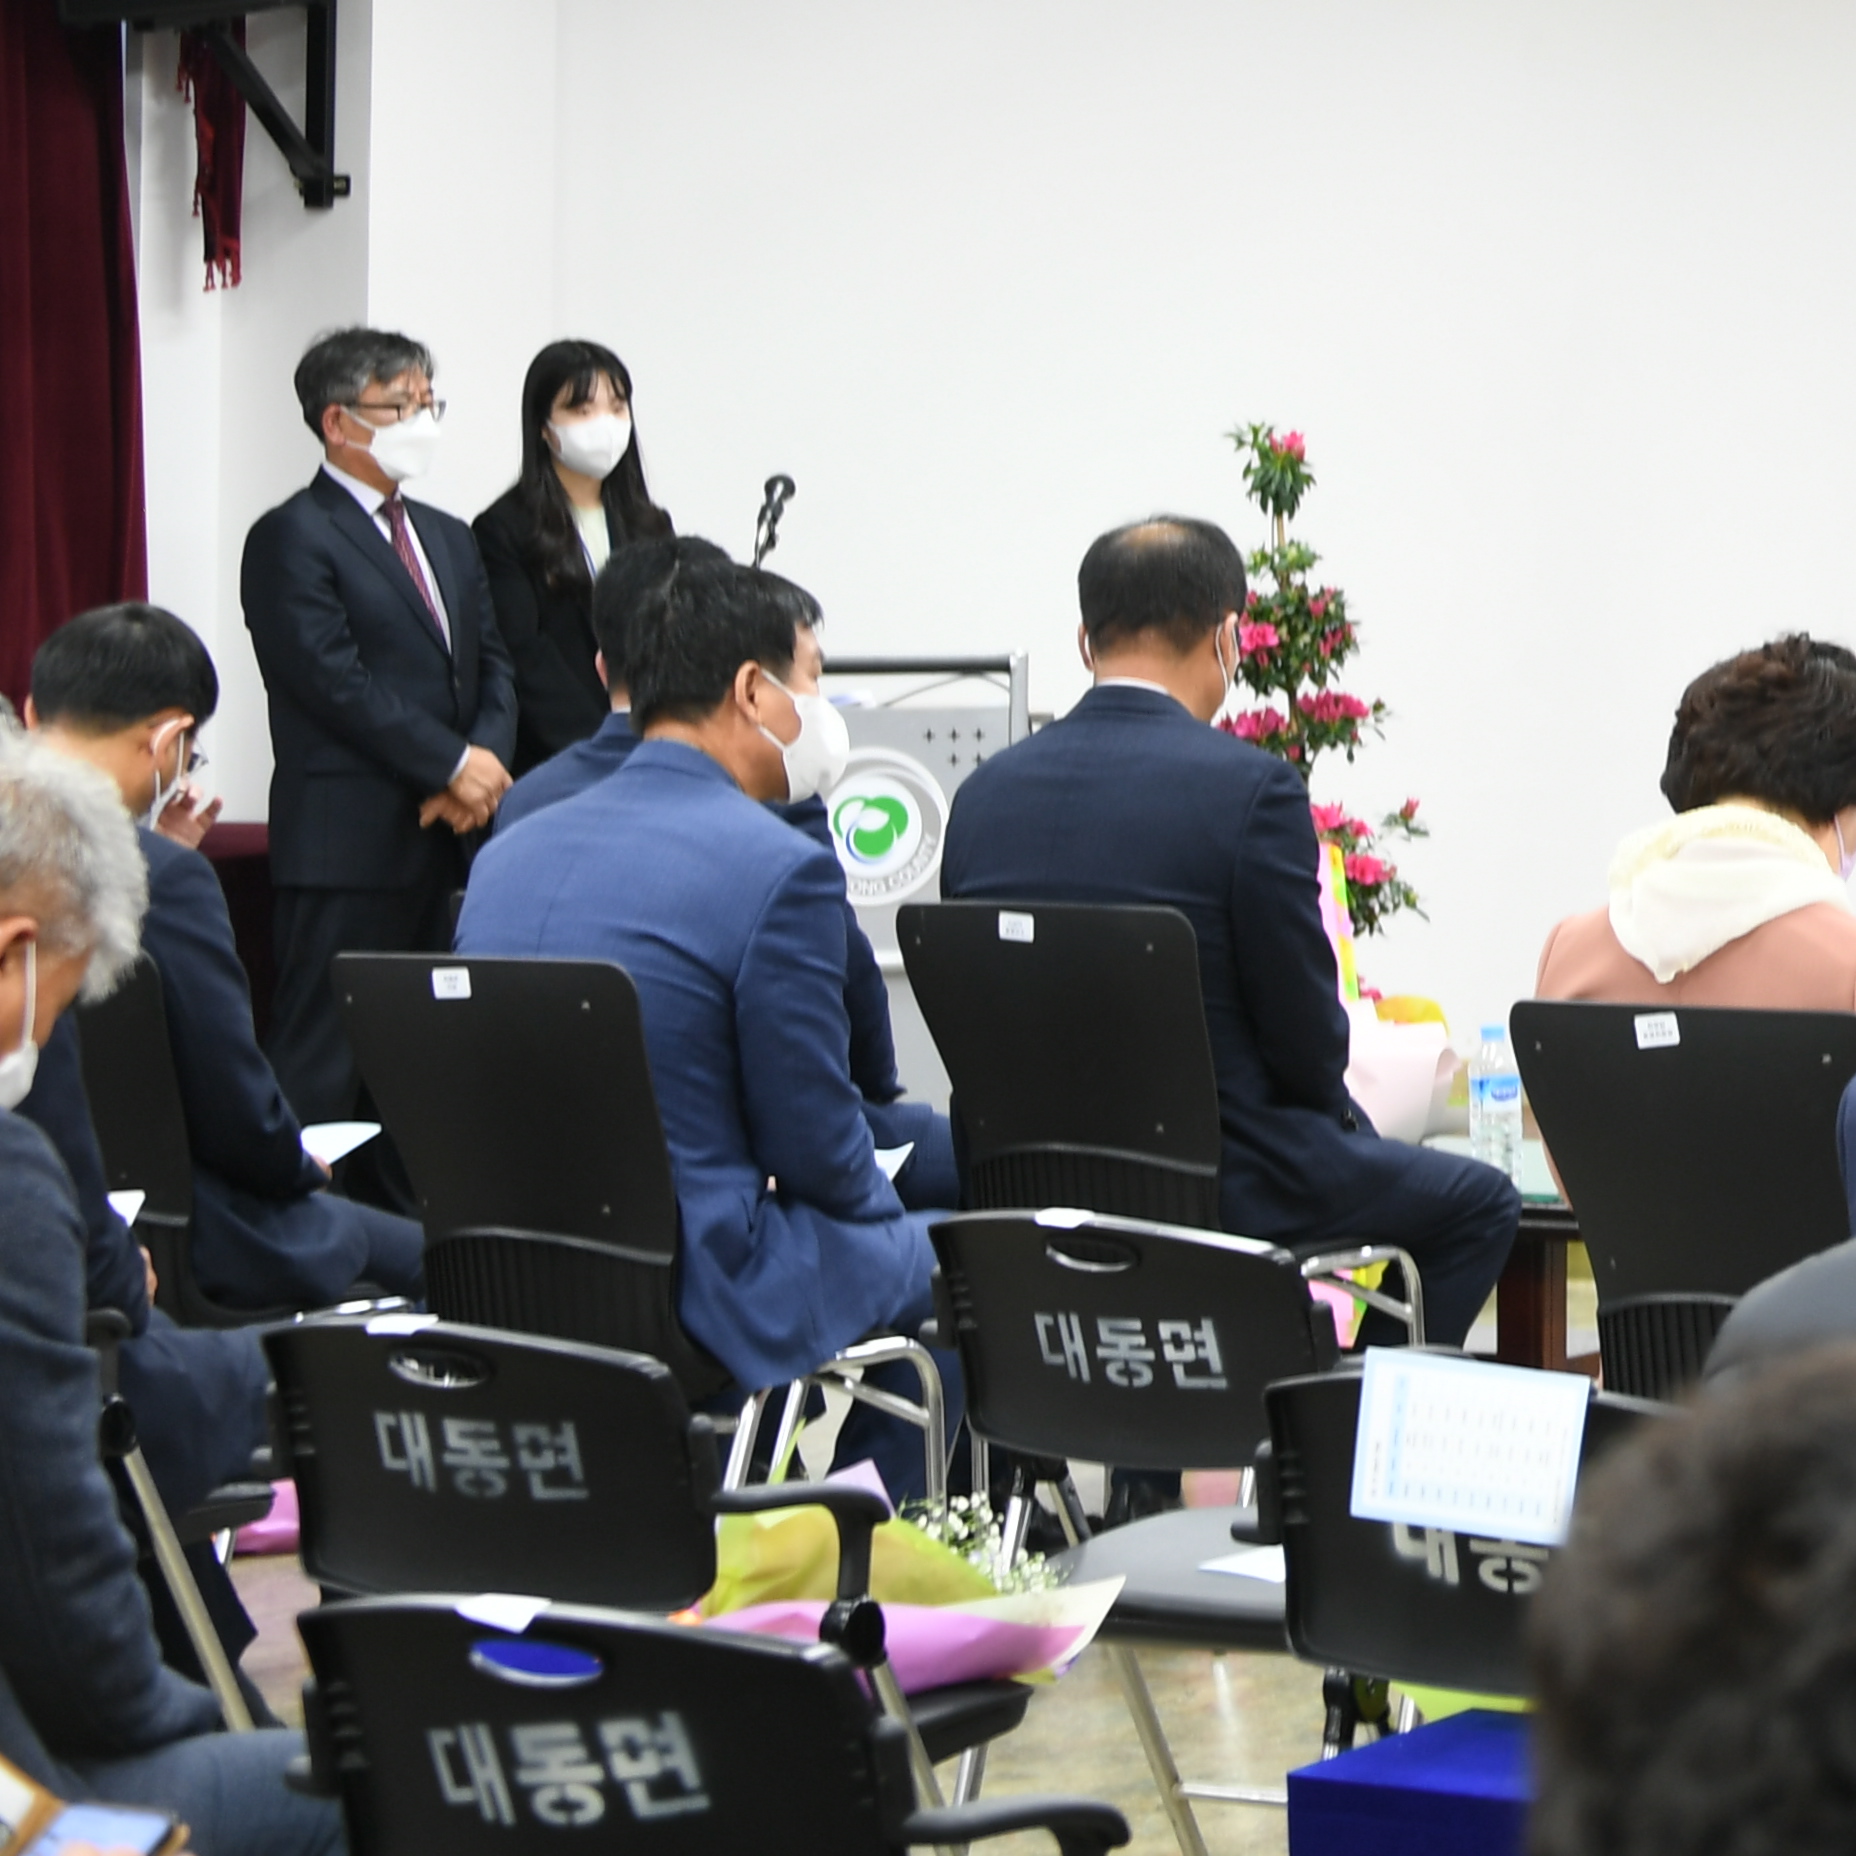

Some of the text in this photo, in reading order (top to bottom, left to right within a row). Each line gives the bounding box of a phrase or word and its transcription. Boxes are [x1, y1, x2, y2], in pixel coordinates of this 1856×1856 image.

[1034, 1311, 1227, 1389] 대동면
[374, 1410, 589, 1501] 대동면
[428, 1711, 711, 1828] 대동면
